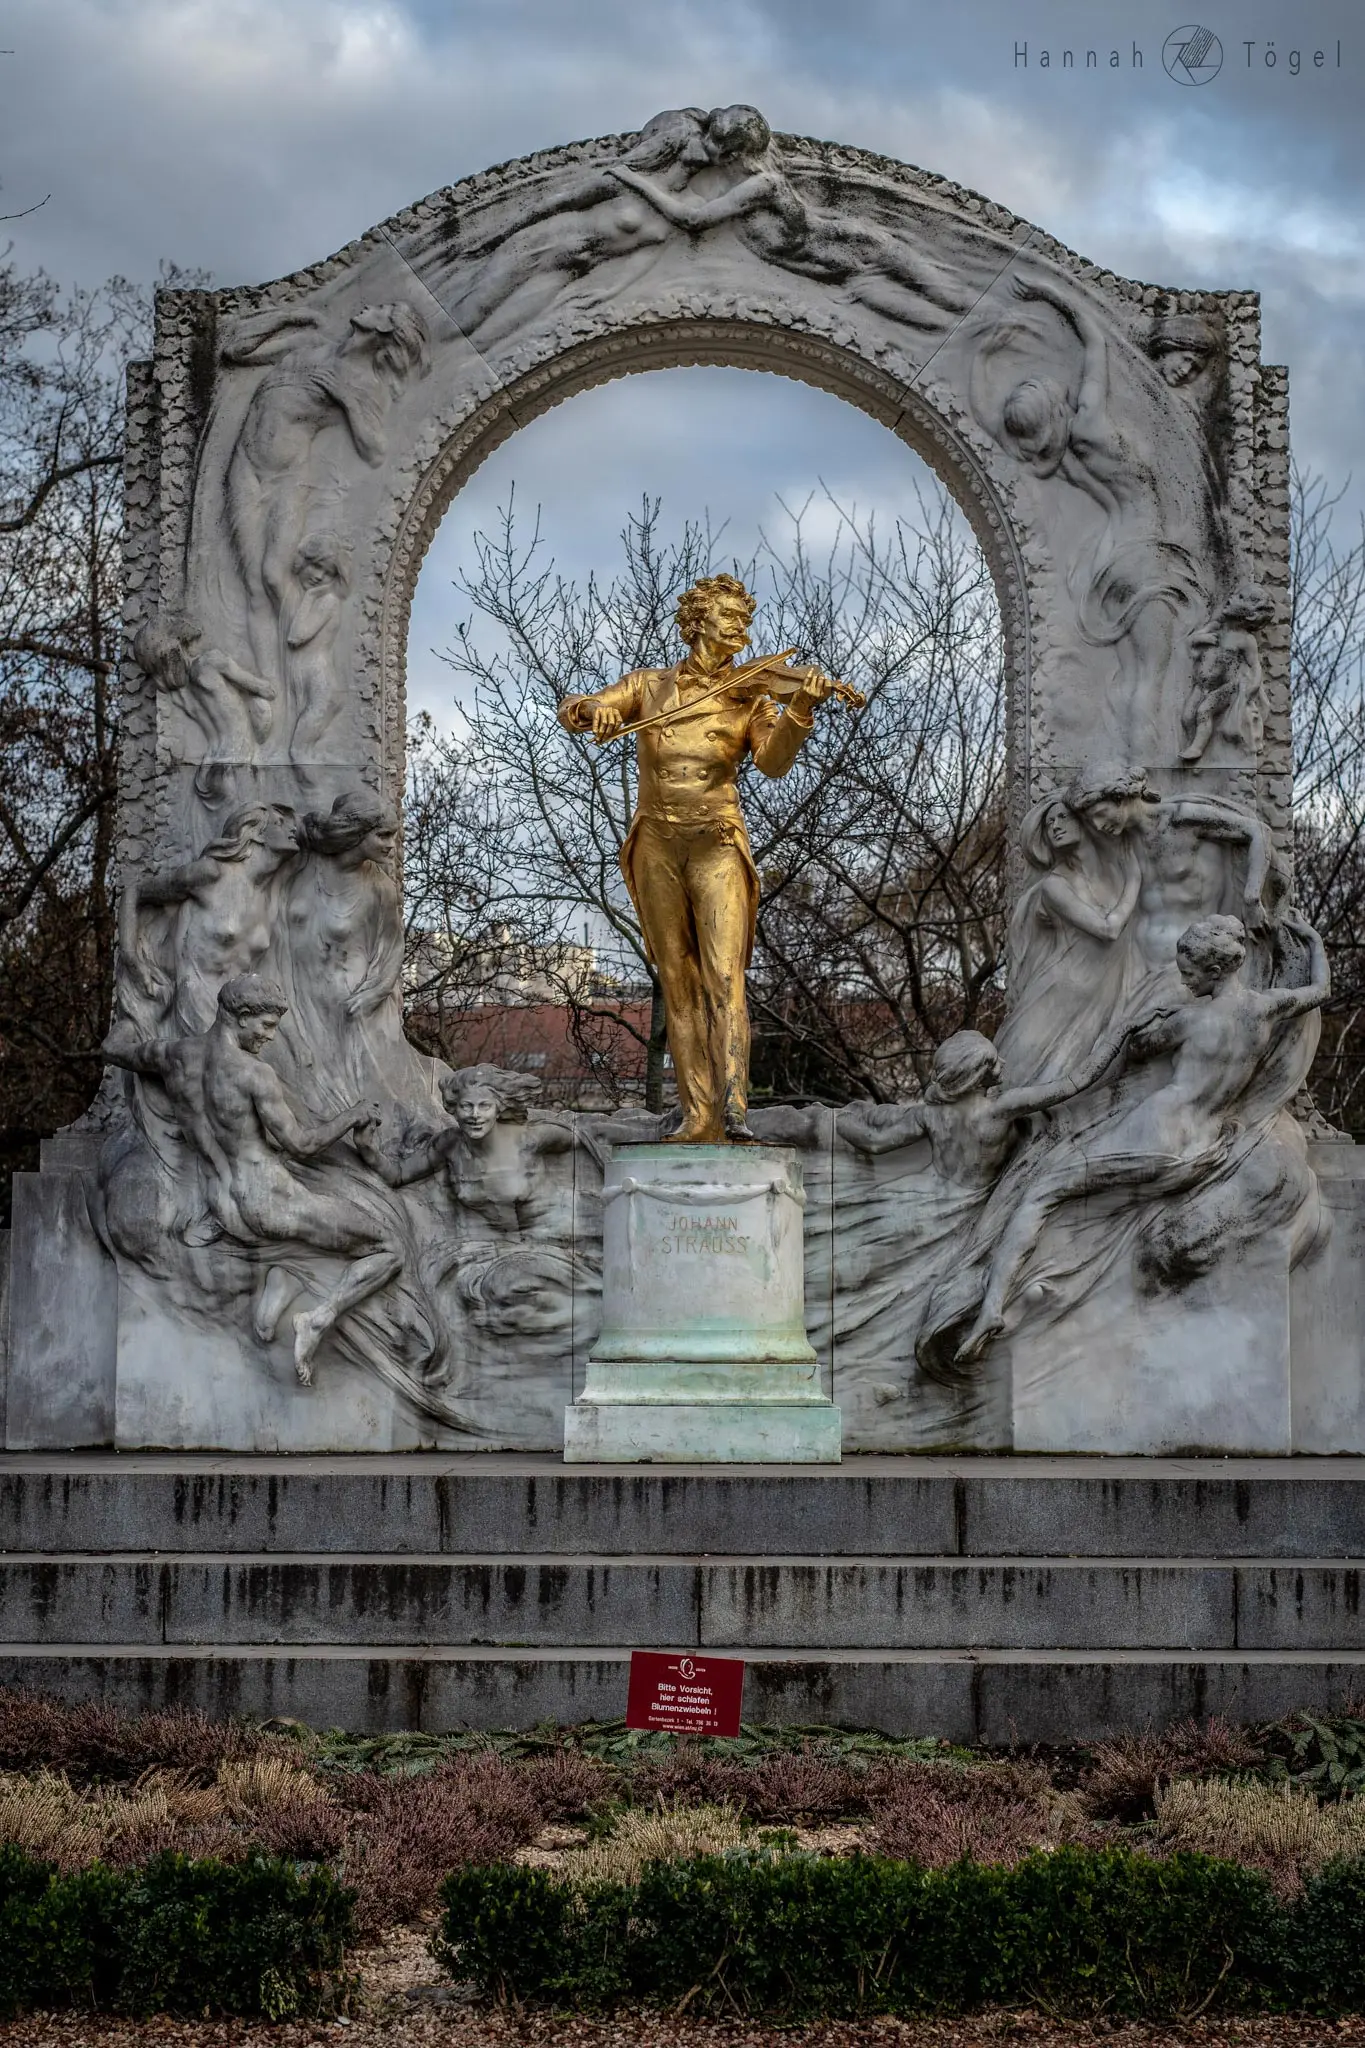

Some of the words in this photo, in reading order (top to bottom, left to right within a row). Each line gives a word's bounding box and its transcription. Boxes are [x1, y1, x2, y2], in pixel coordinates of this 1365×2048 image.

[668, 1216, 738, 1231] JOHANN
[662, 1236, 747, 1254] STRAUSS
[658, 1683, 676, 1692] Bitte
[680, 1685, 713, 1696] Vorsicht,
[660, 1693, 674, 1702] hier
[678, 1695, 710, 1705] schlafen
[651, 1703, 711, 1715] Blumenzwiebeln
